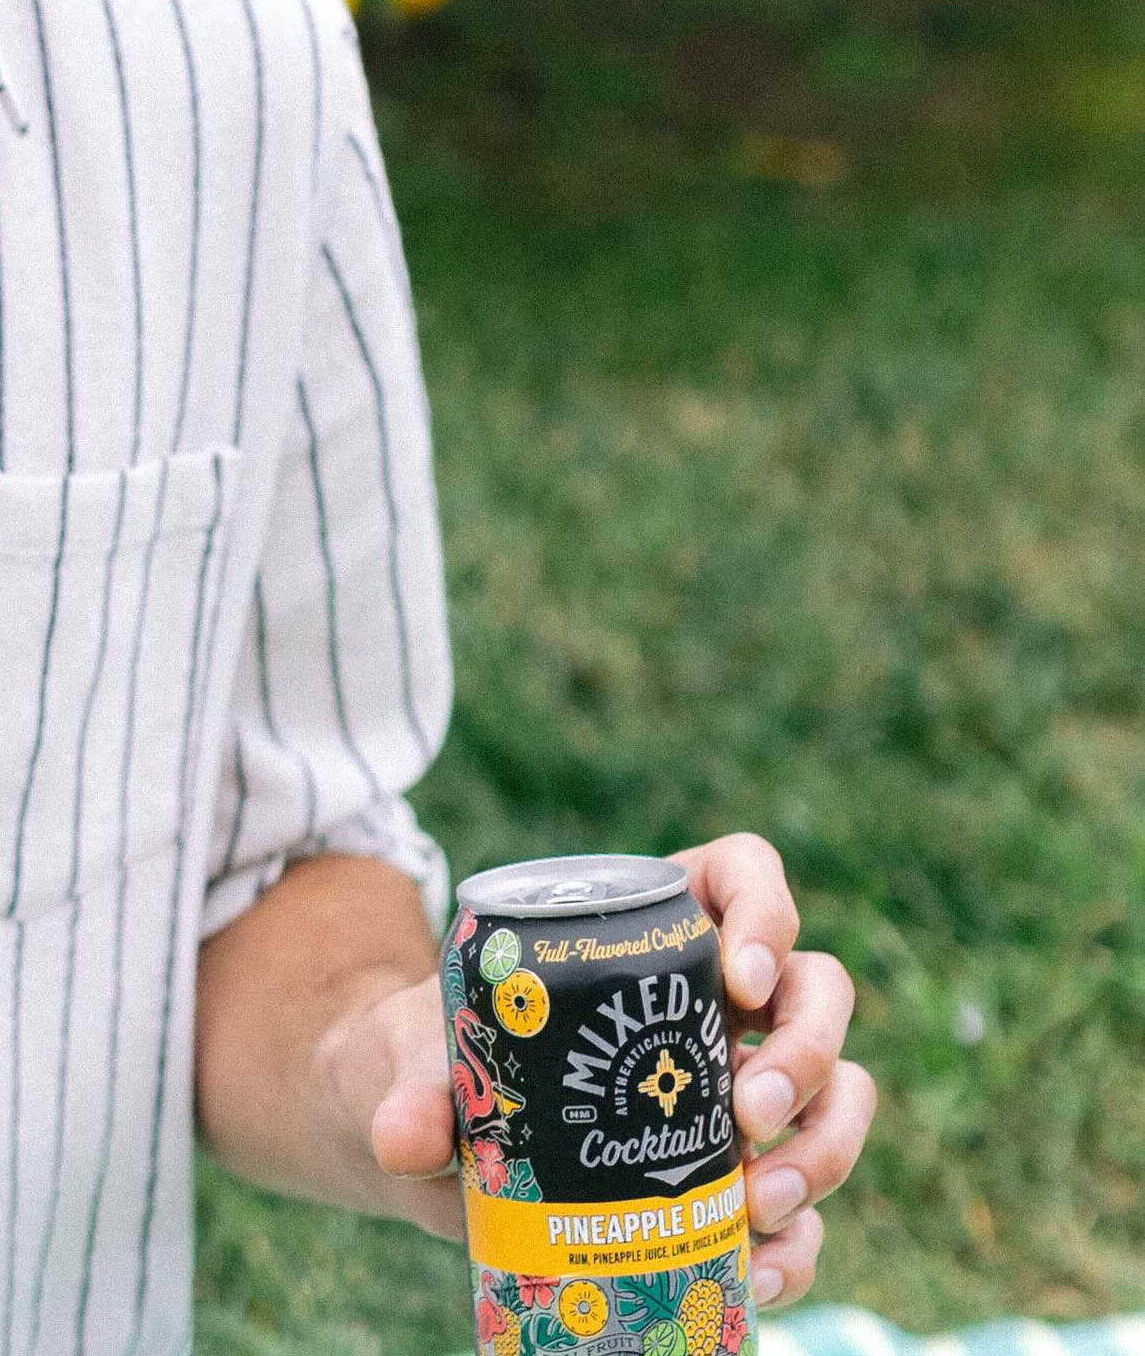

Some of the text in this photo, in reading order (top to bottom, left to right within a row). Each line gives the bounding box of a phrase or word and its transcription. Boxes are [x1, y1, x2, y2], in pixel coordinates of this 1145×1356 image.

[534, 932, 650, 964] Full-Flavored
[652, 924, 686, 952] Craft
[614, 1030, 710, 1116] AUTHENTICALLY CRAFTED
[580, 1114, 705, 1168] Cocktail
[547, 1204, 685, 1245] PINEAPPLE
[593, 1249, 641, 1265] PINEAPPLE
[672, 1241, 690, 1256] LIME
[586, 1336, 635, 1356] FRUIT
